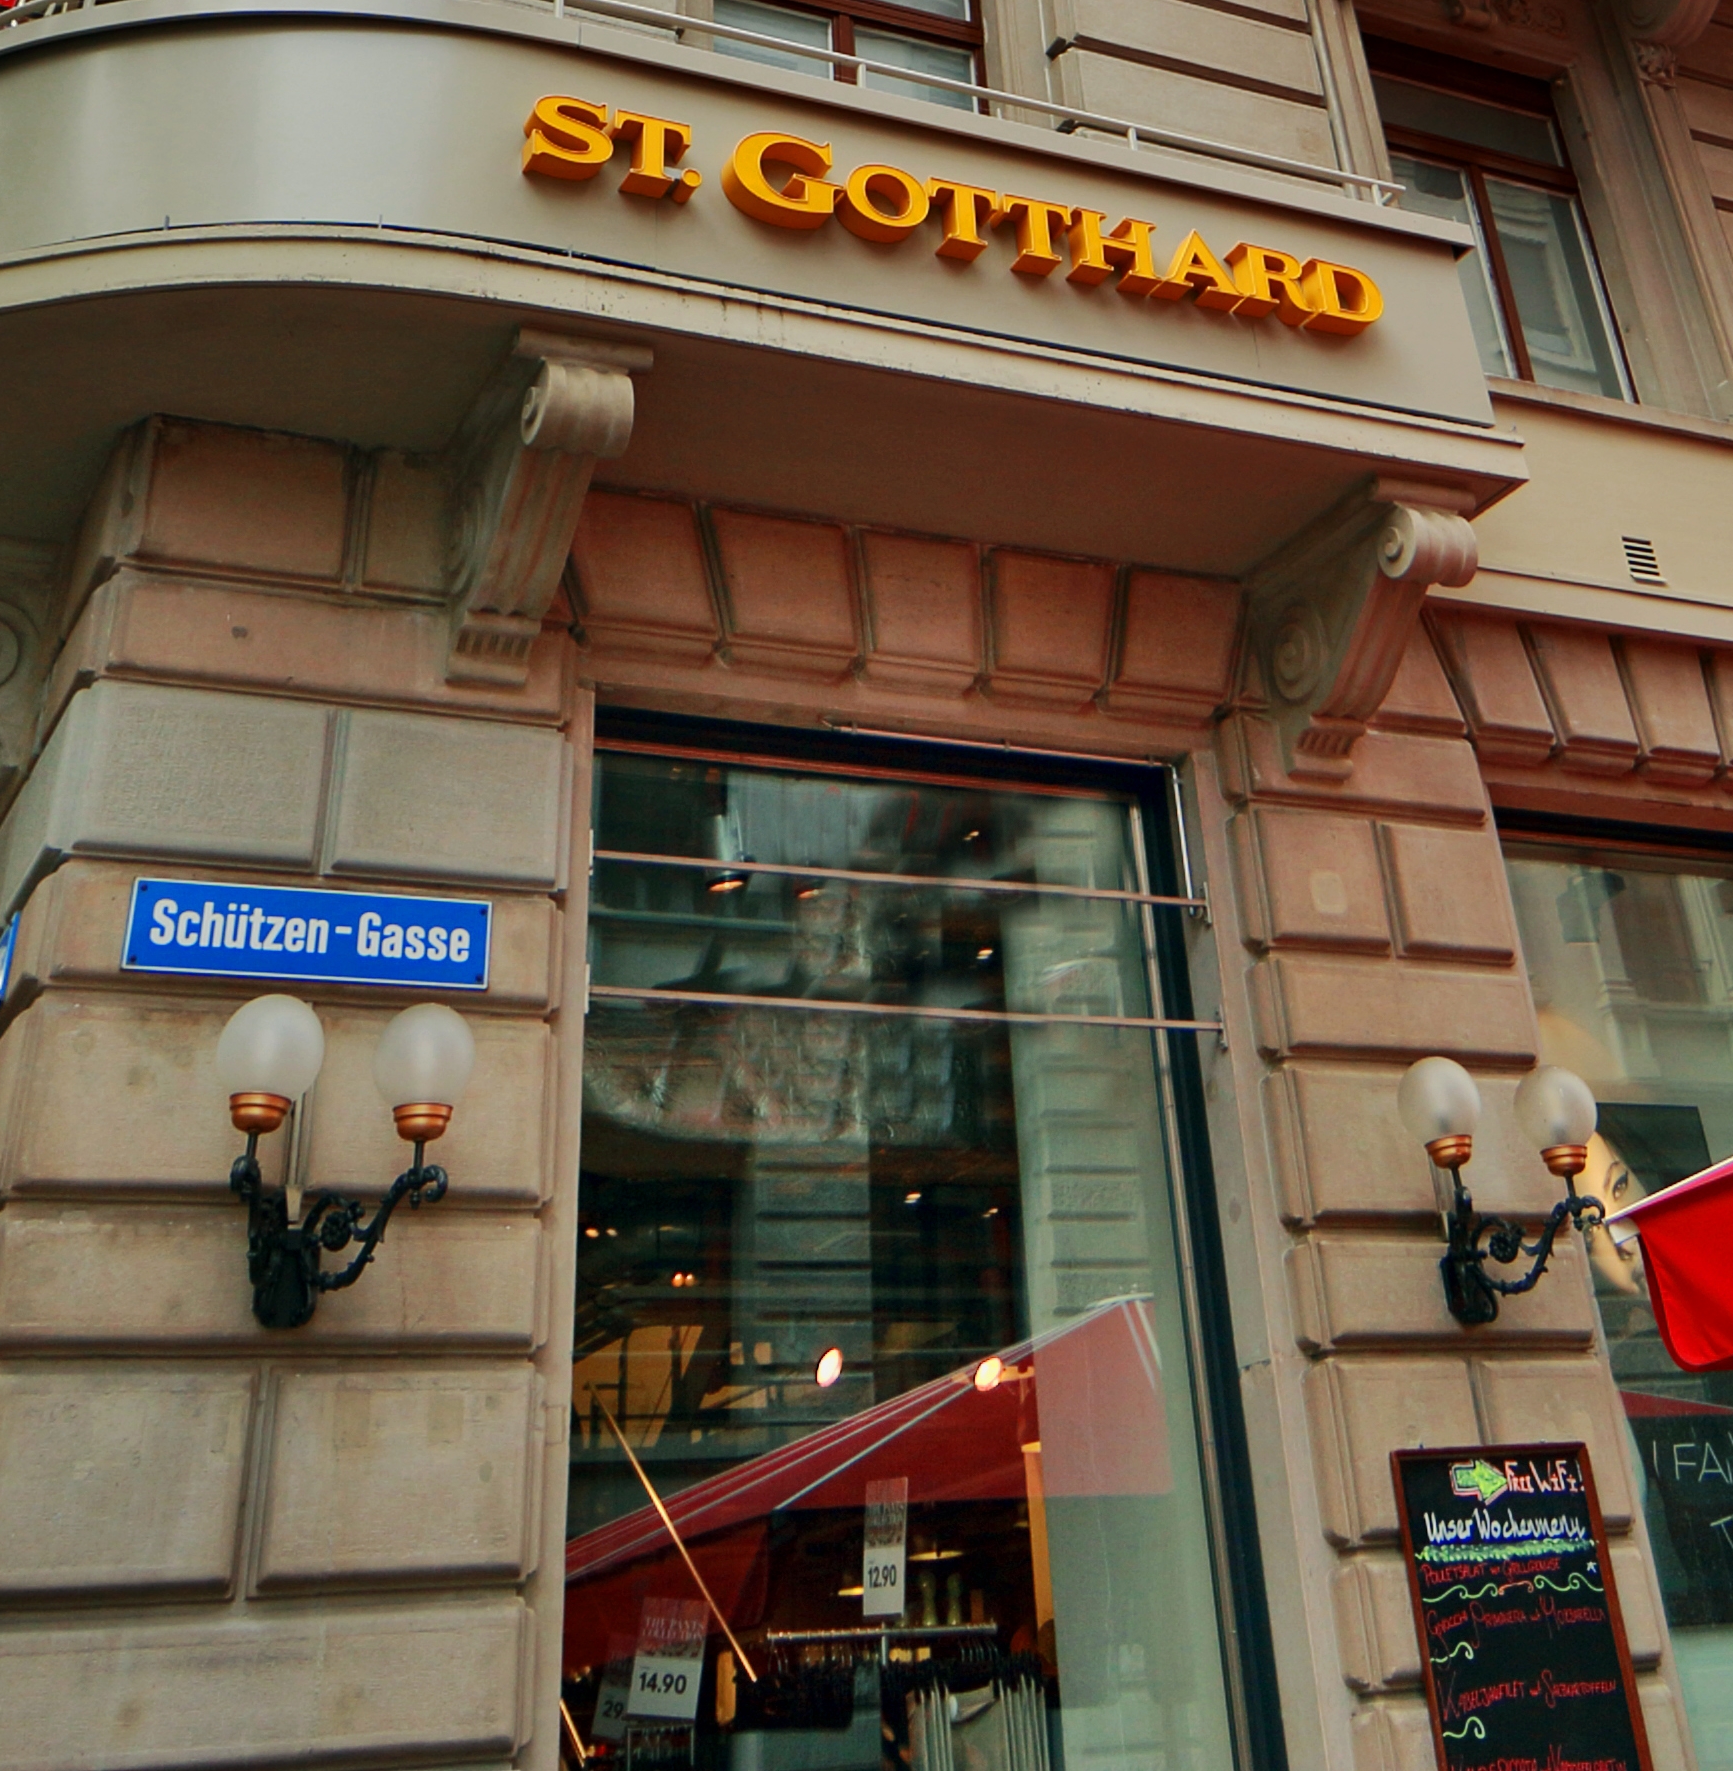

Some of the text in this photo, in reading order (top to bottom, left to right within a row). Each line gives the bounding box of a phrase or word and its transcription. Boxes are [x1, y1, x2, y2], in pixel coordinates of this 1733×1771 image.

[720, 130, 1384, 337] GOTTHARD
[1423, 1511, 1473, 1544] Unser
[868, 1564, 897, 1588] 12.90
[639, 1672, 687, 1695] 14.90
